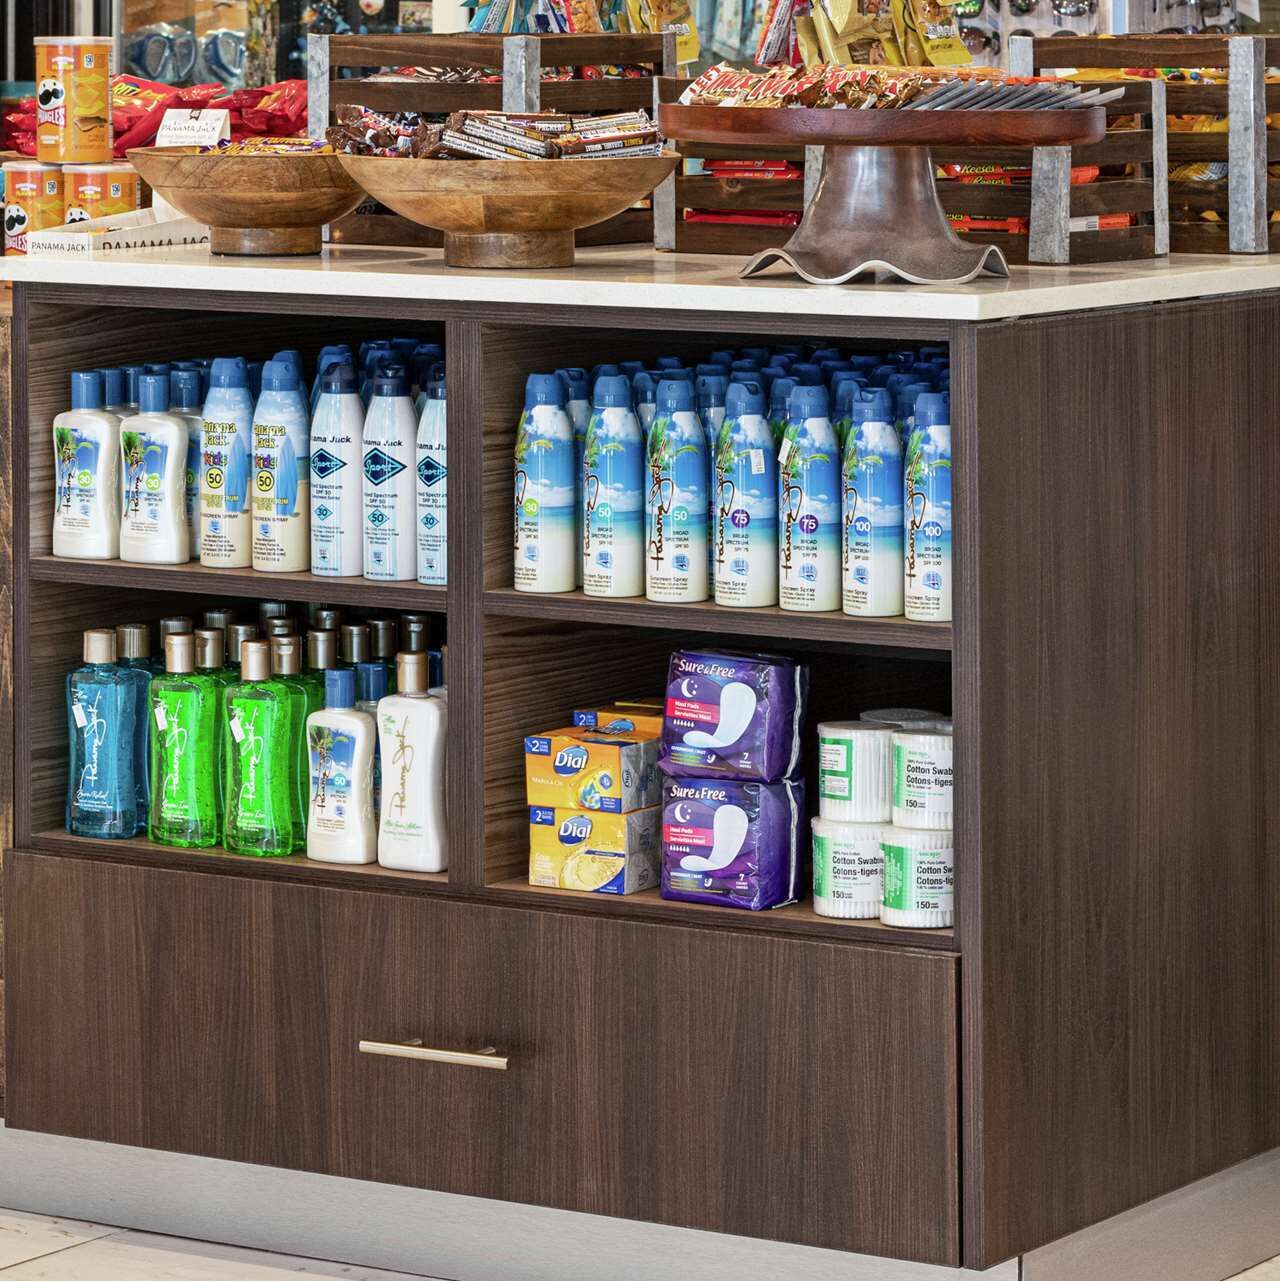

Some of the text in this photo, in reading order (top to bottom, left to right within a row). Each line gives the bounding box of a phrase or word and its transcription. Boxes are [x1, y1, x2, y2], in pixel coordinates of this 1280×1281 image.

[161, 122, 216, 133] PANAMA JACK
[32, 241, 86, 252] PANAMA JACK
[204, 451, 228, 468] kids
[255, 453, 277, 470] kids
[80, 475, 90, 484] 30
[147, 478, 159, 488] 30
[208, 473, 221, 484] 50
[259, 475, 272, 487] 50
[598, 507, 611, 517] 50
[372, 514, 384, 523] 50
[734, 514, 747, 524] 75
[802, 519, 816, 529] 75
[855, 521, 870, 531] 100
[924, 527, 940, 536] 100
[679, 660, 735, 678] Sure&Free
[555, 751, 587, 769] Dial
[907, 764, 930, 774] Cotton
[907, 775, 952, 787] Cotons-tiges
[906, 799, 917, 808] 150
[560, 823, 592, 838] Dial
[832, 856, 855, 865] Cotton
[832, 867, 878, 878] Cotons-tiges
[917, 866, 941, 874] Cotton
[832, 890, 844, 899] 150
[917, 901, 930, 909] 150
